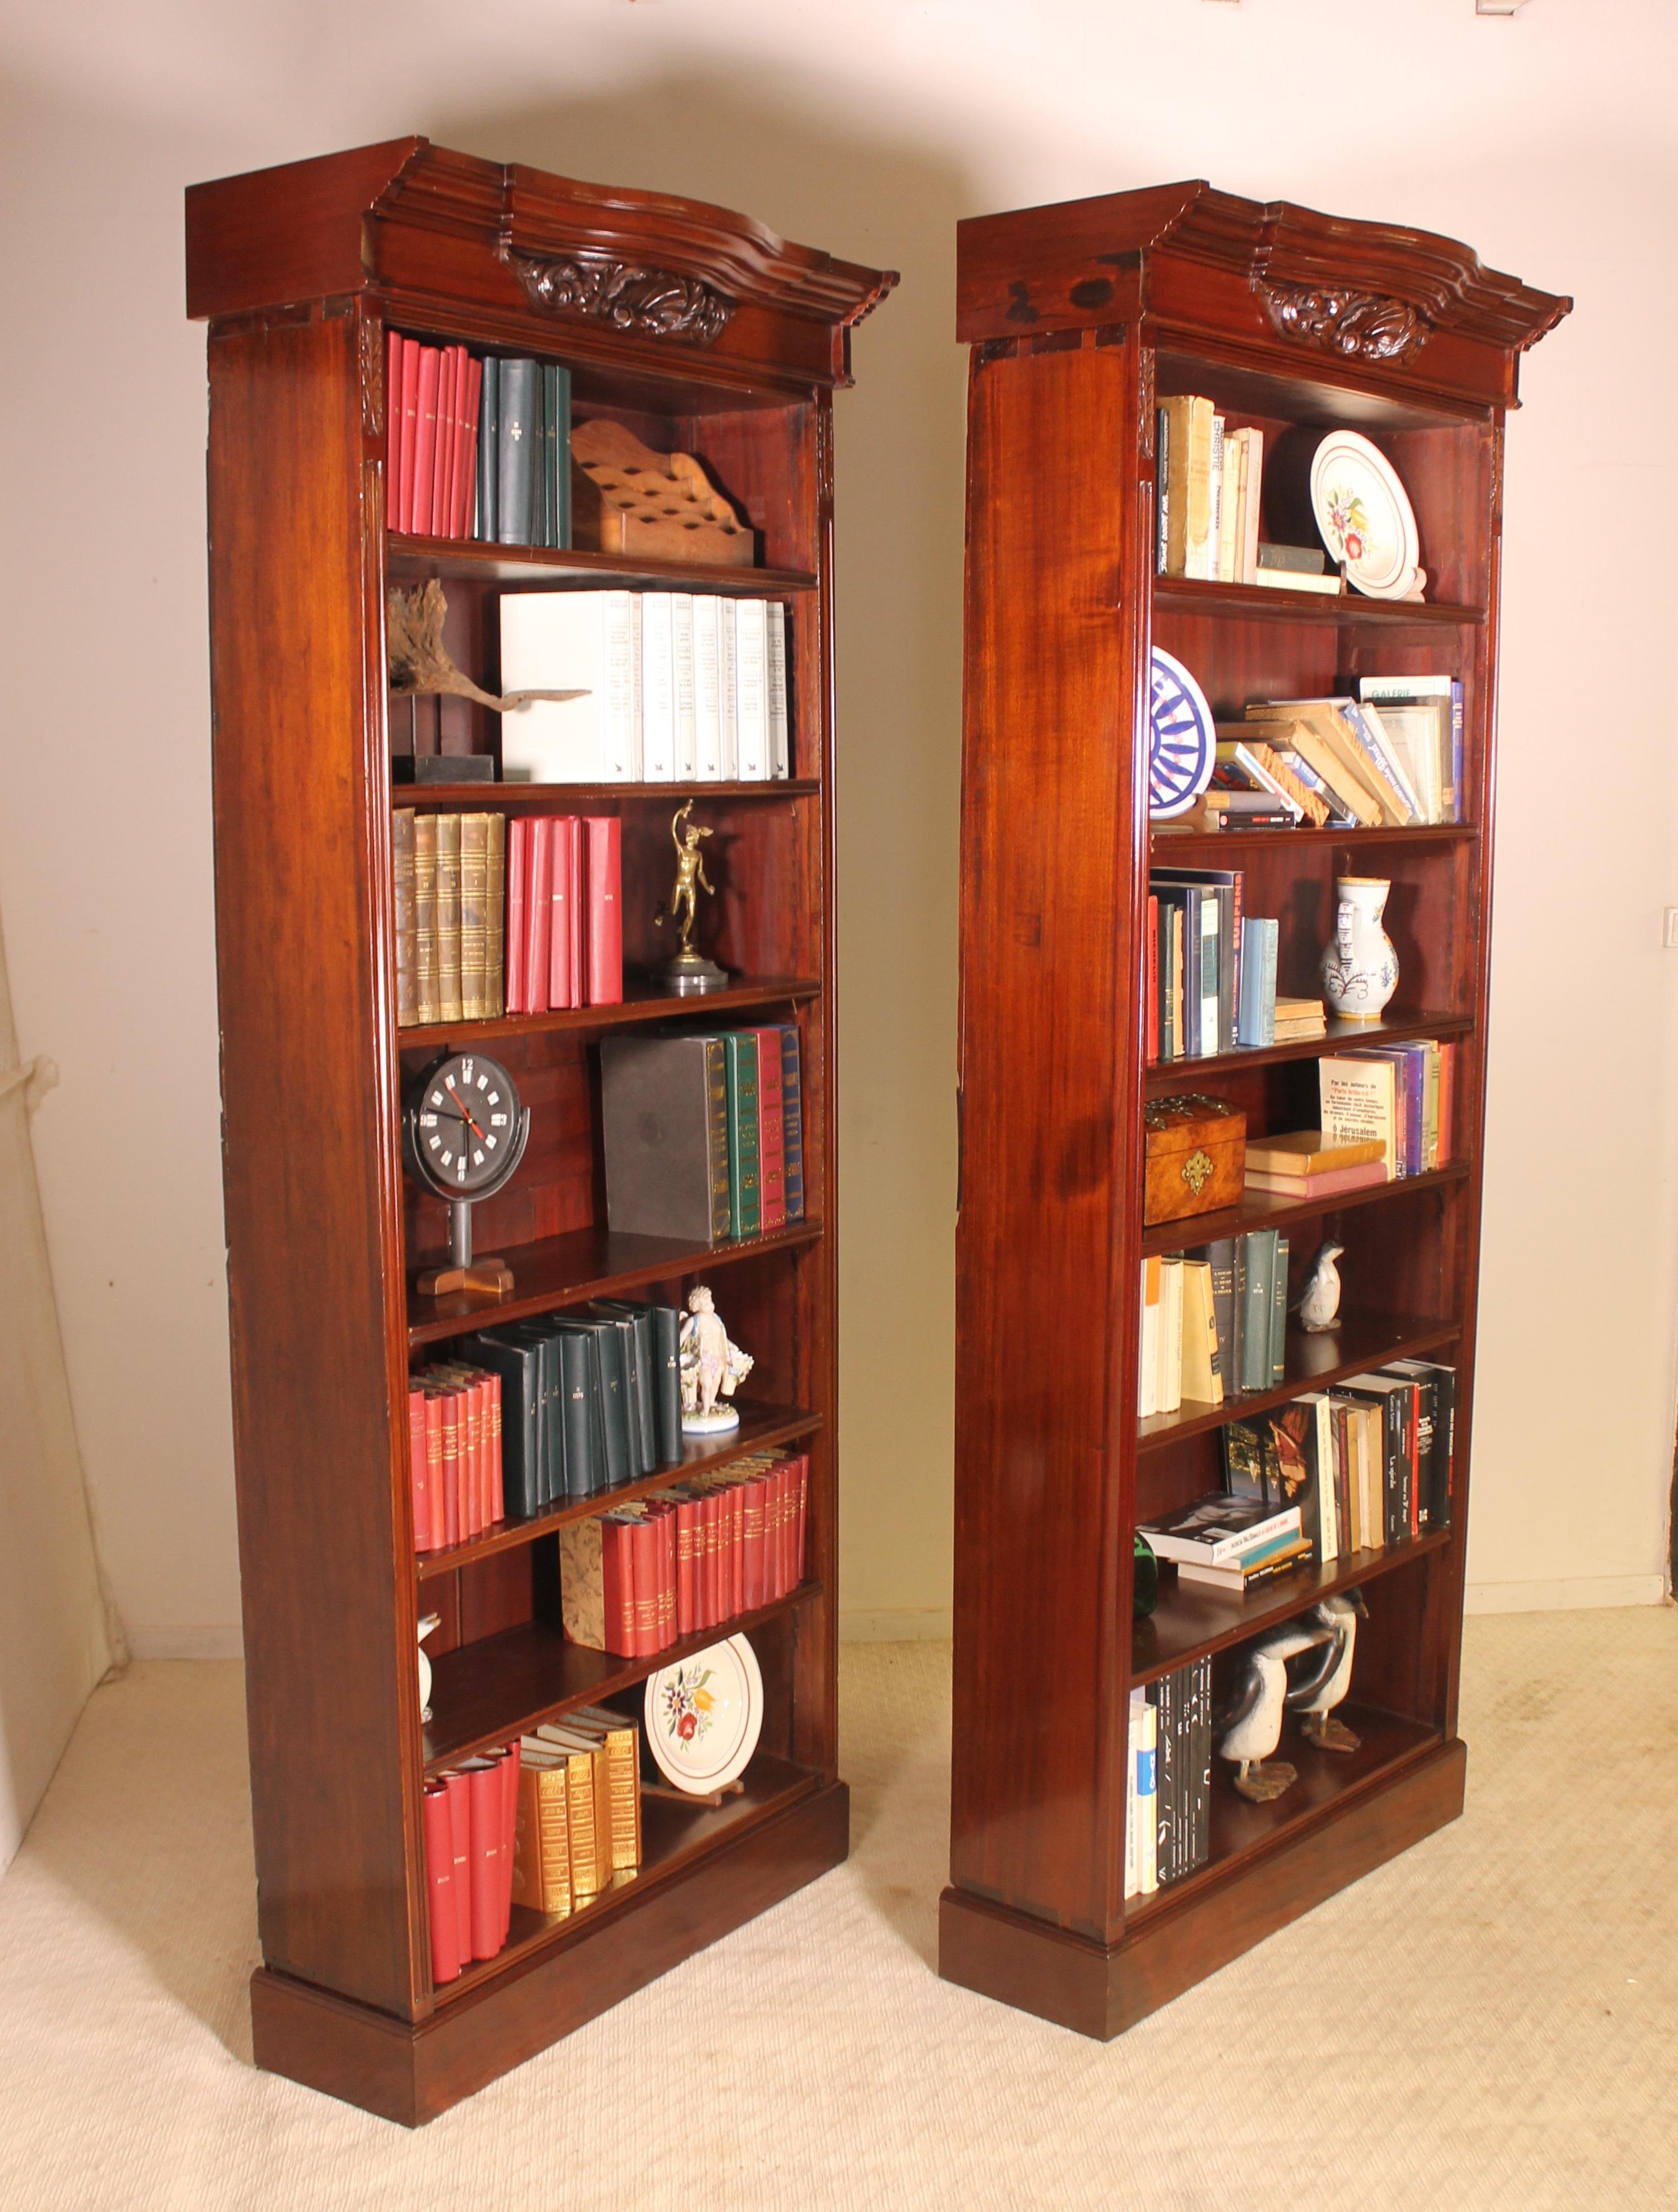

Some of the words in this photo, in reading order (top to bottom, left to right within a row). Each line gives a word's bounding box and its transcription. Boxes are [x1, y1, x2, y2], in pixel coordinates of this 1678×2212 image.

[1212, 420, 1220, 471] CHRISTIE
[1371, 688, 1411, 699] GALERIE
[1234, 874, 1242, 950] SUSPENS
[462, 1058, 474, 1070] 12
[500, 1113, 508, 1126] 3
[1340, 1125, 1377, 1137] Jérusalem
[458, 1170, 465, 1182] 6
